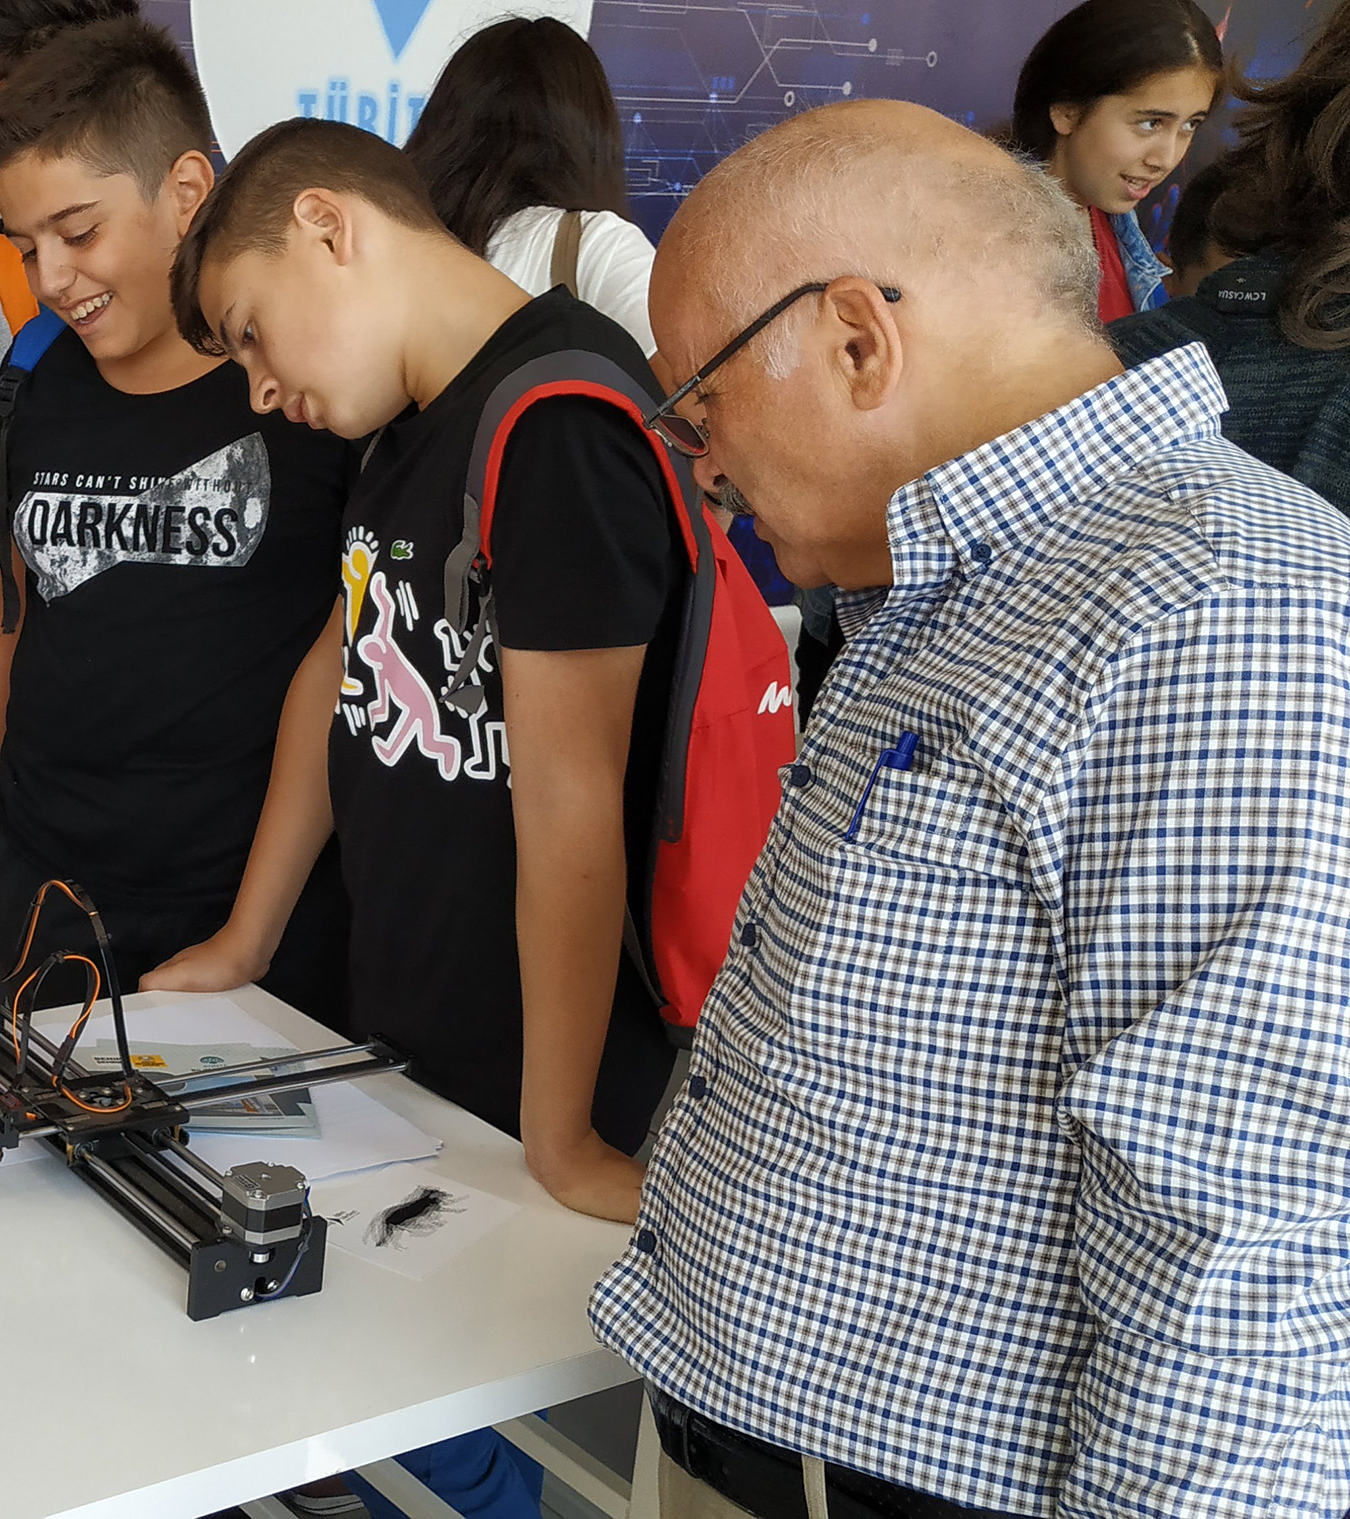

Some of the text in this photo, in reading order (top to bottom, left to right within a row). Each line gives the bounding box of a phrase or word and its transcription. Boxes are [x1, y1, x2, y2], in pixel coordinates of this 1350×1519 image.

[32, 471, 69, 487] STARS
[75, 474, 122, 490] CAN'T
[129, 476, 176, 492] SHINE
[27, 498, 239, 558] DARKNESS
